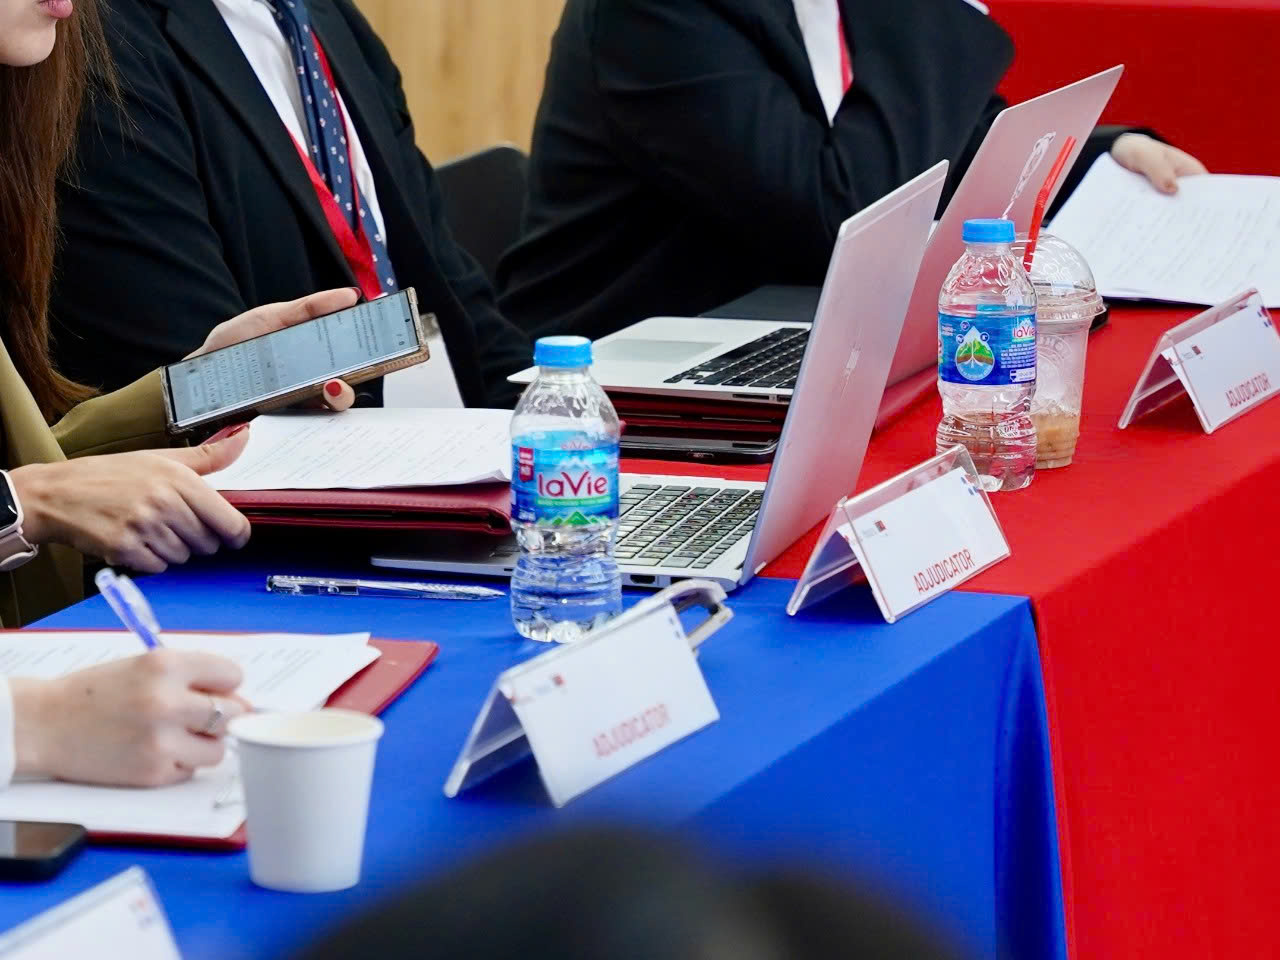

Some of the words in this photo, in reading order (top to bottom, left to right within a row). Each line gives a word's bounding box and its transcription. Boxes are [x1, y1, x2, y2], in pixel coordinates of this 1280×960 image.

[1225, 373, 1272, 408] ADJUDICATOR
[536, 470, 608, 497] laVie
[913, 548, 975, 593] ADJUDICATOR
[593, 703, 670, 759] ADJUDICATOR
